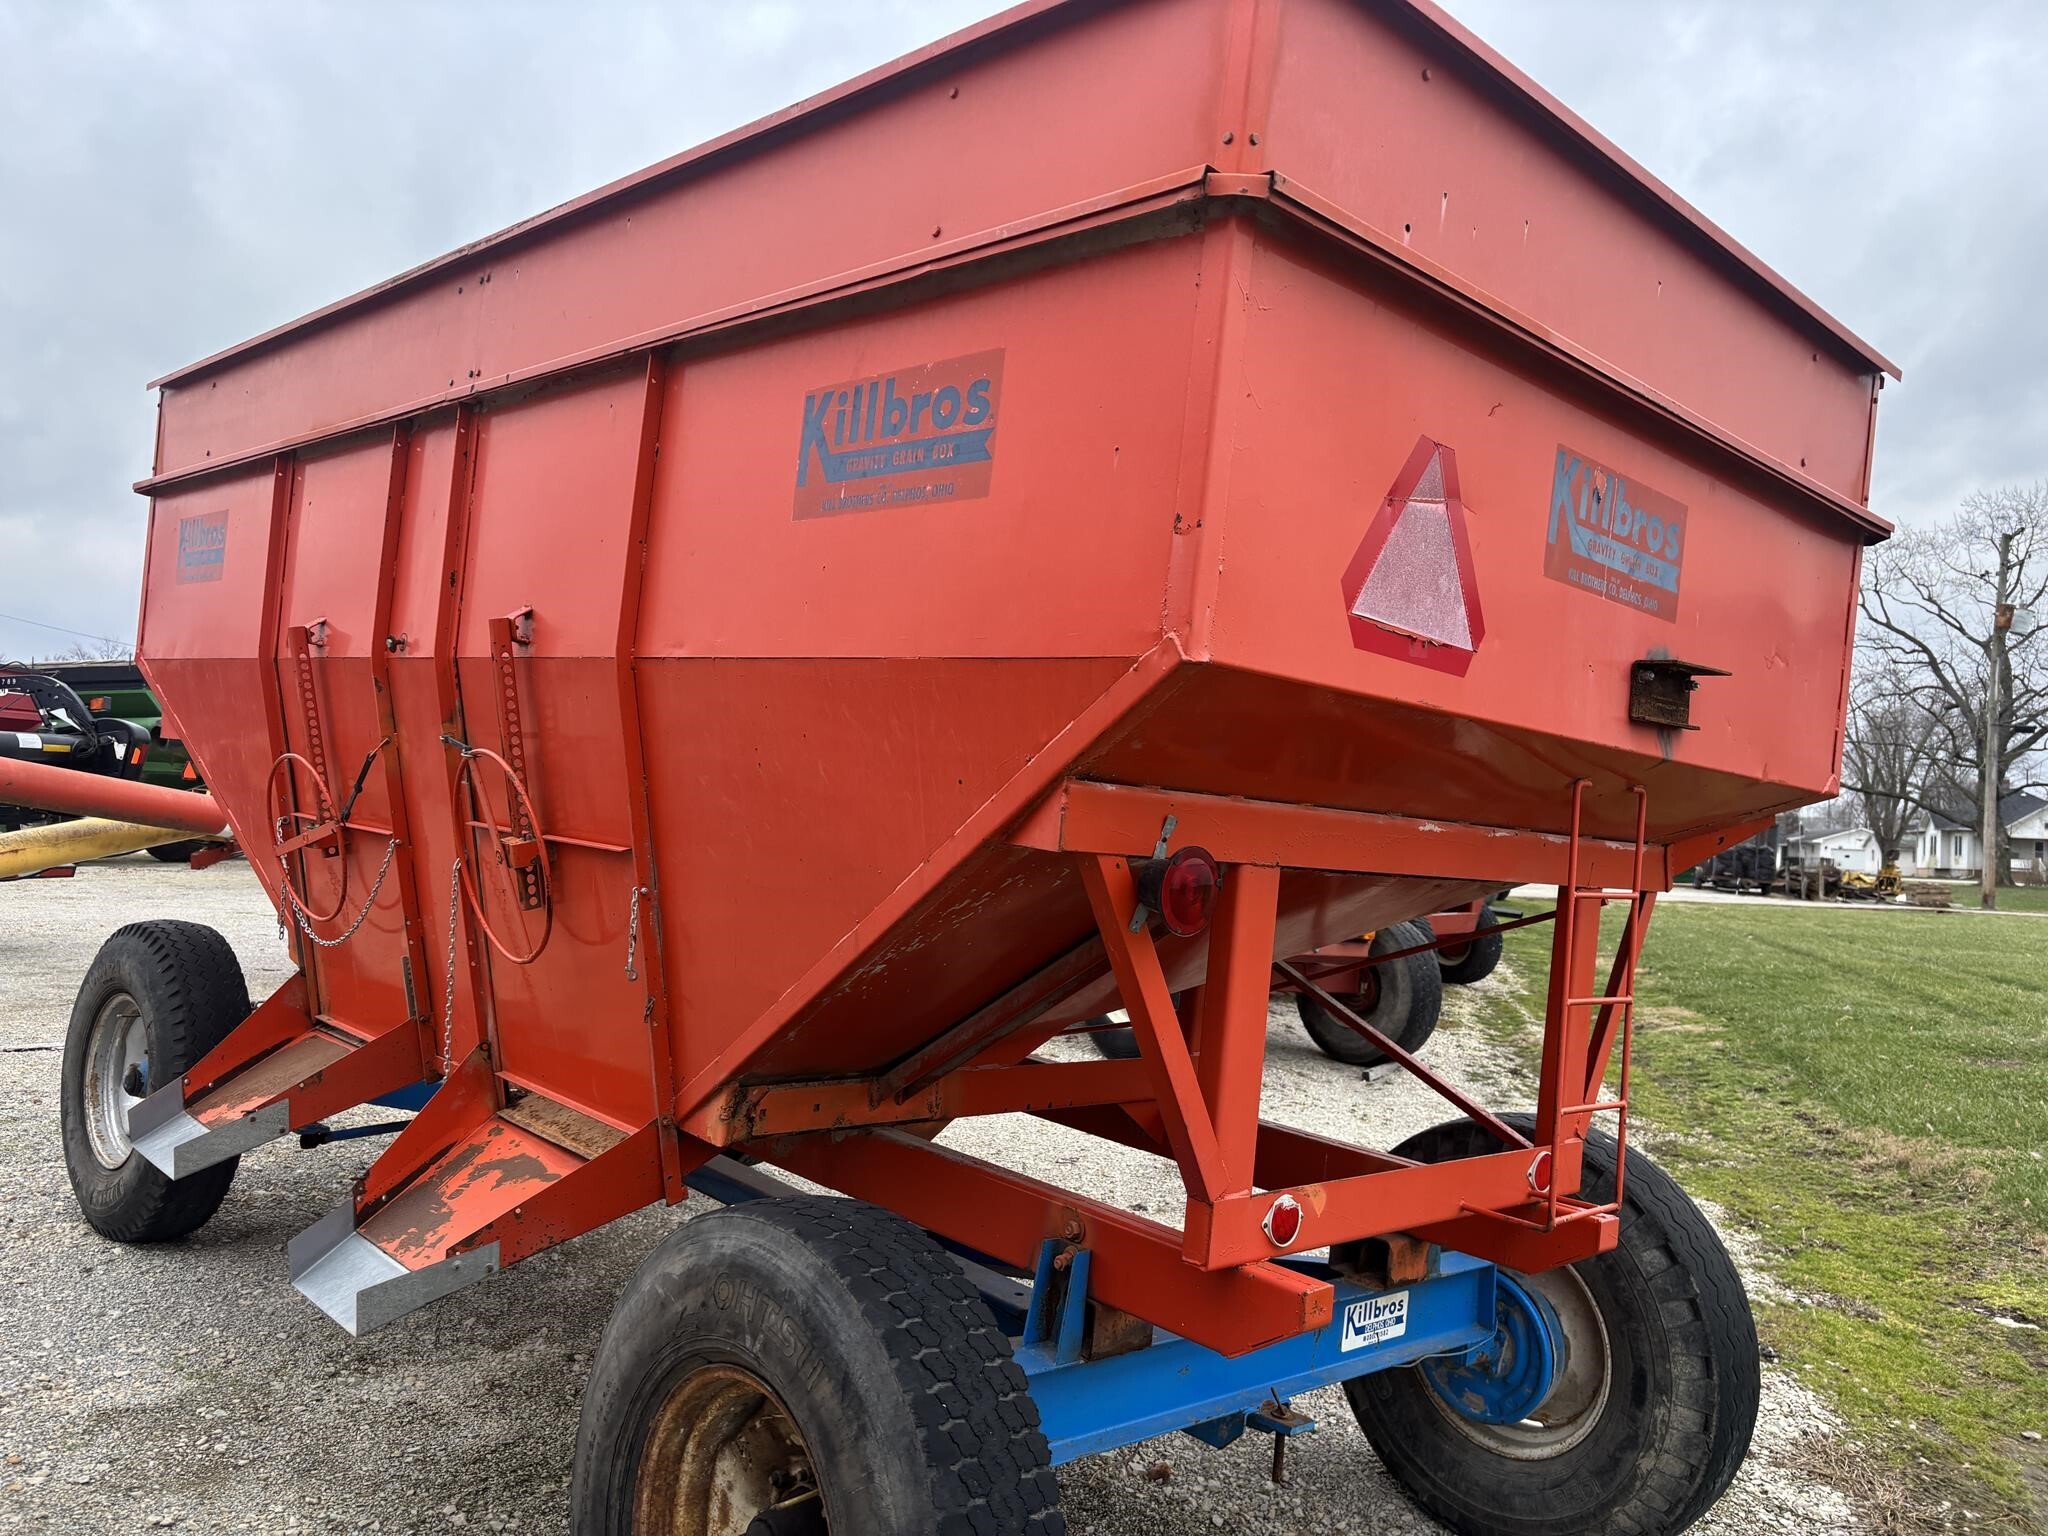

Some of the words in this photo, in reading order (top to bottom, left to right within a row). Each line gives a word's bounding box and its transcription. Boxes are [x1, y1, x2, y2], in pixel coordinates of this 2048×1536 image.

[797, 376, 992, 488] Killbros
[847, 453, 886, 473] GRAVITY
[893, 447, 925, 466] GRAIN
[932, 442, 955, 460] BOX
[931, 483, 954, 497] OHIO
[1547, 449, 1680, 561] Killbros
[1587, 538, 1616, 561] GRAVITY
[1345, 1299, 1404, 1339] Killbros
